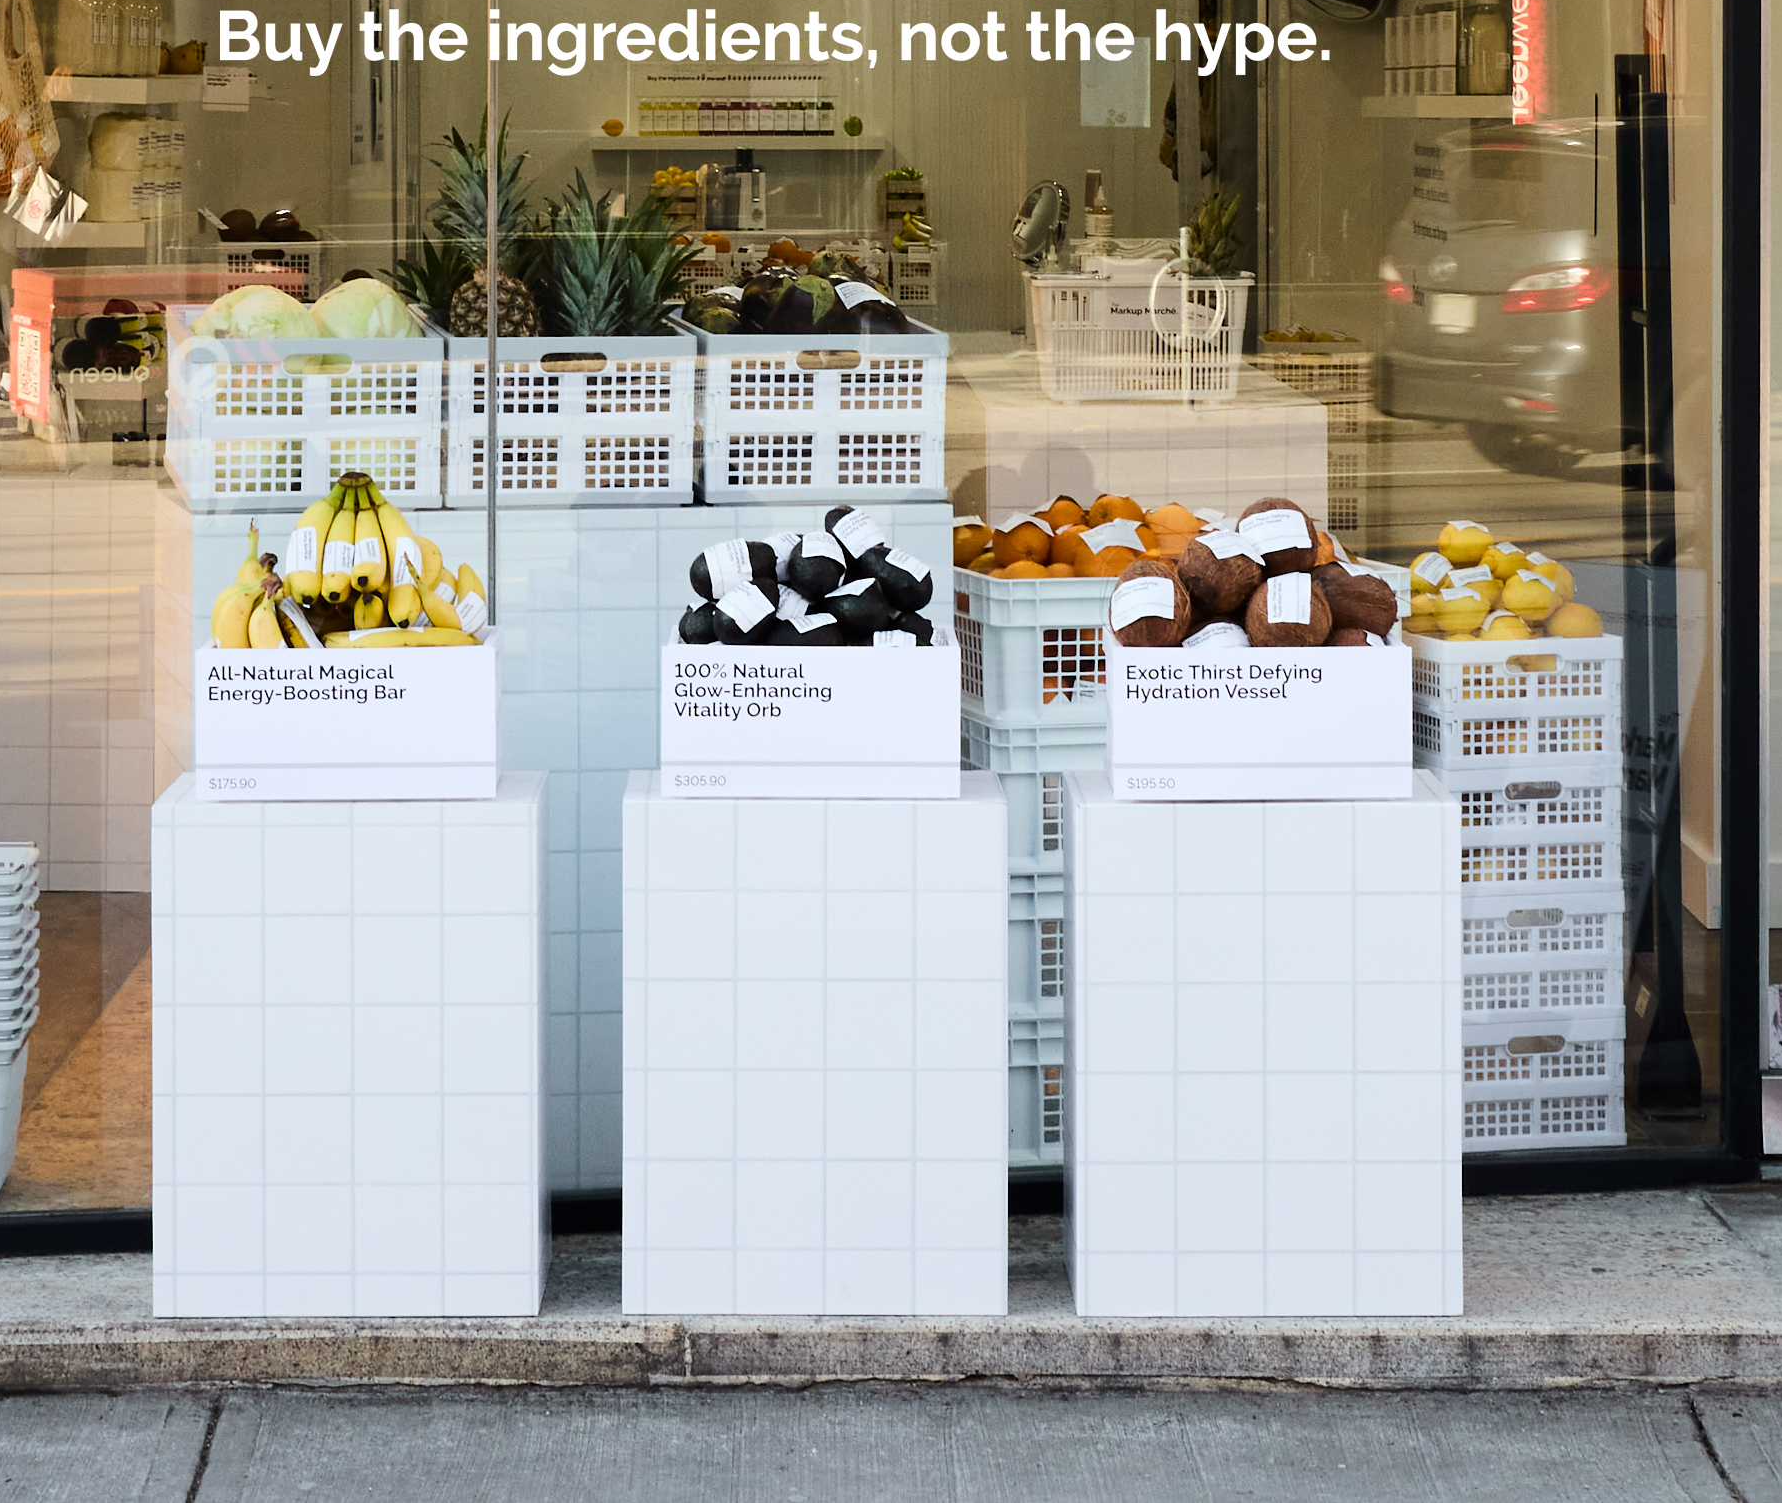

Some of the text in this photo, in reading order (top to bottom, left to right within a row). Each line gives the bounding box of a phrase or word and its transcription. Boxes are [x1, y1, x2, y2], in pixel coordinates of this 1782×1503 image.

[219, 9, 1330, 77] Buy the ingredients, not the hype.
[1110, 307, 1143, 316] Markup
[208, 664, 394, 684] All-Natural Magical
[674, 663, 805, 679] 100% Natural
[1126, 664, 1322, 684] Exotic Thirst Defying
[208, 684, 406, 705] Energy-Boosting Bar
[674, 682, 832, 703] Glow-Enhancing
[1126, 683, 1287, 704] Hydration Vessel
[674, 701, 782, 722] Vitality Orb
[209, 778, 257, 790] $175.90
[674, 775, 726, 787] $305.90
[1127, 777, 1174, 789] $195.50
